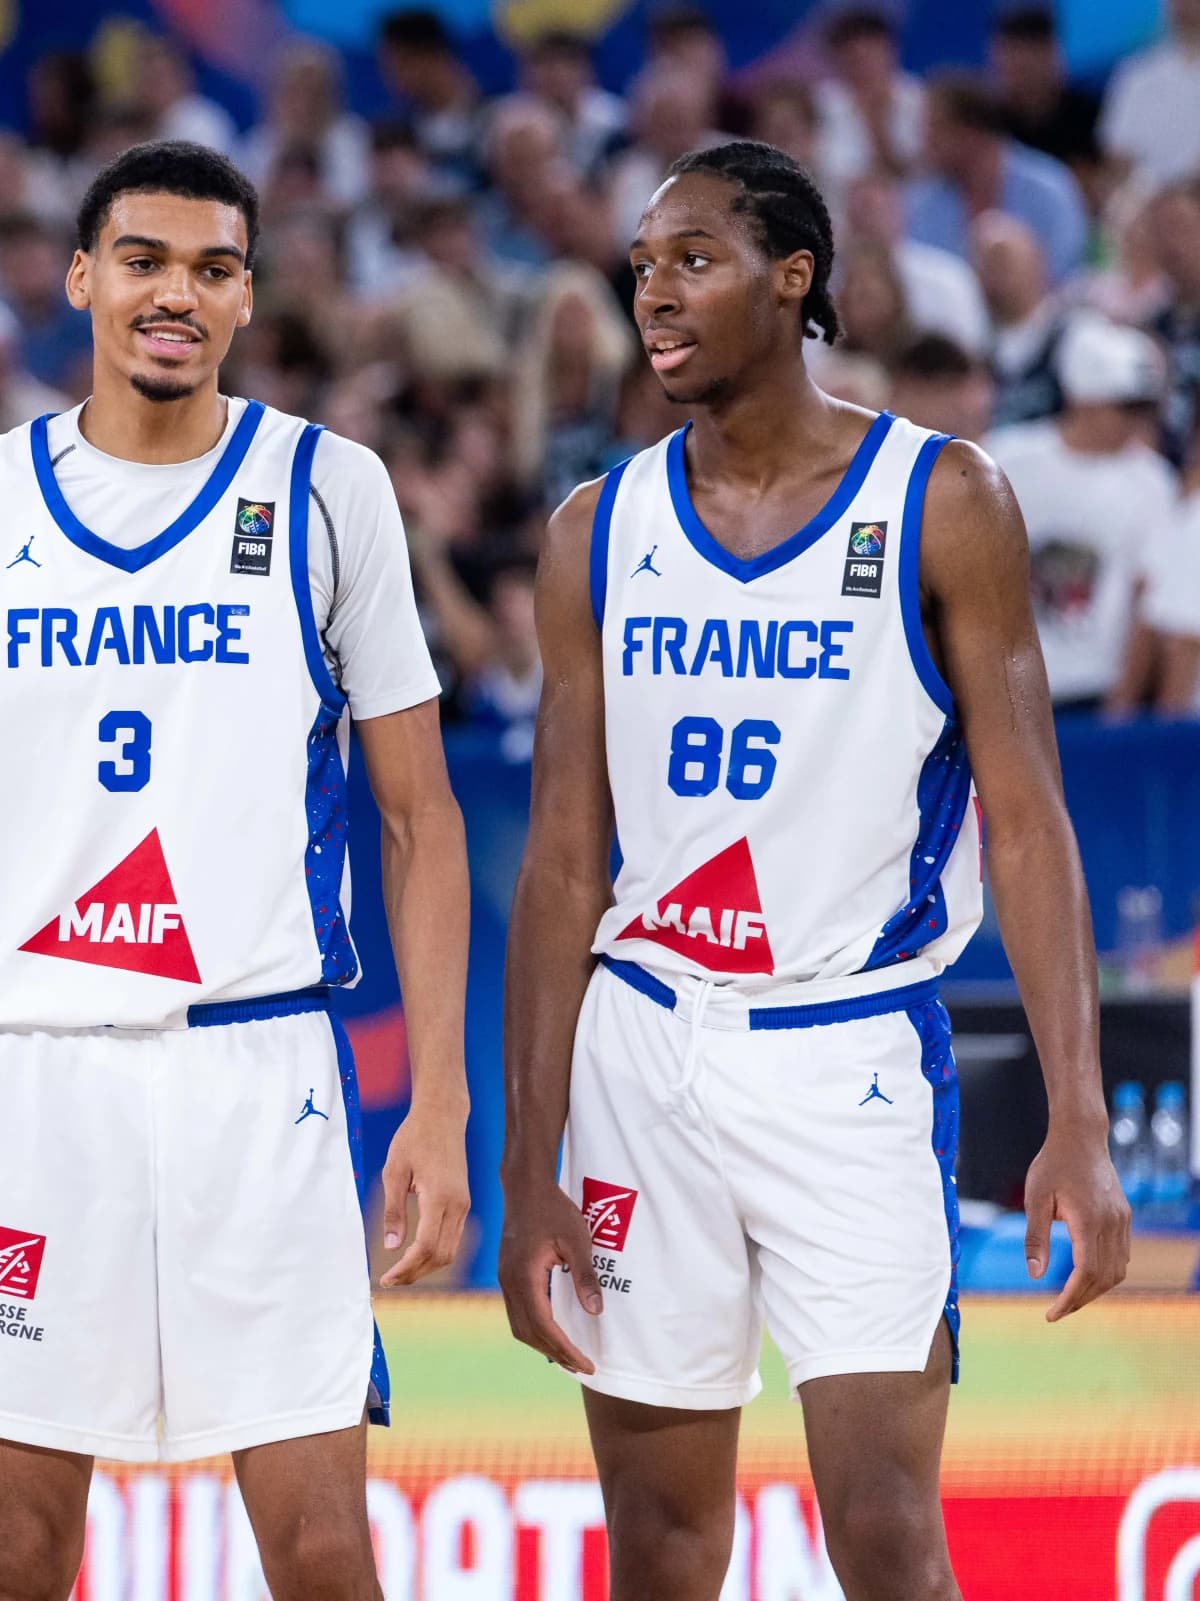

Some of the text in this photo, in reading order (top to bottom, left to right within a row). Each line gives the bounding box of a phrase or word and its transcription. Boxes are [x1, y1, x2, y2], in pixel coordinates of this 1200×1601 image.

[238, 542, 266, 556] FIBA
[850, 564, 877, 578] FIBA
[7, 603, 250, 668] FRANCE
[622, 616, 853, 680] FRANCE
[99, 711, 152, 792] 3
[668, 716, 781, 800] 86
[58, 902, 181, 944] MAIF
[642, 903, 767, 950] MAIF
